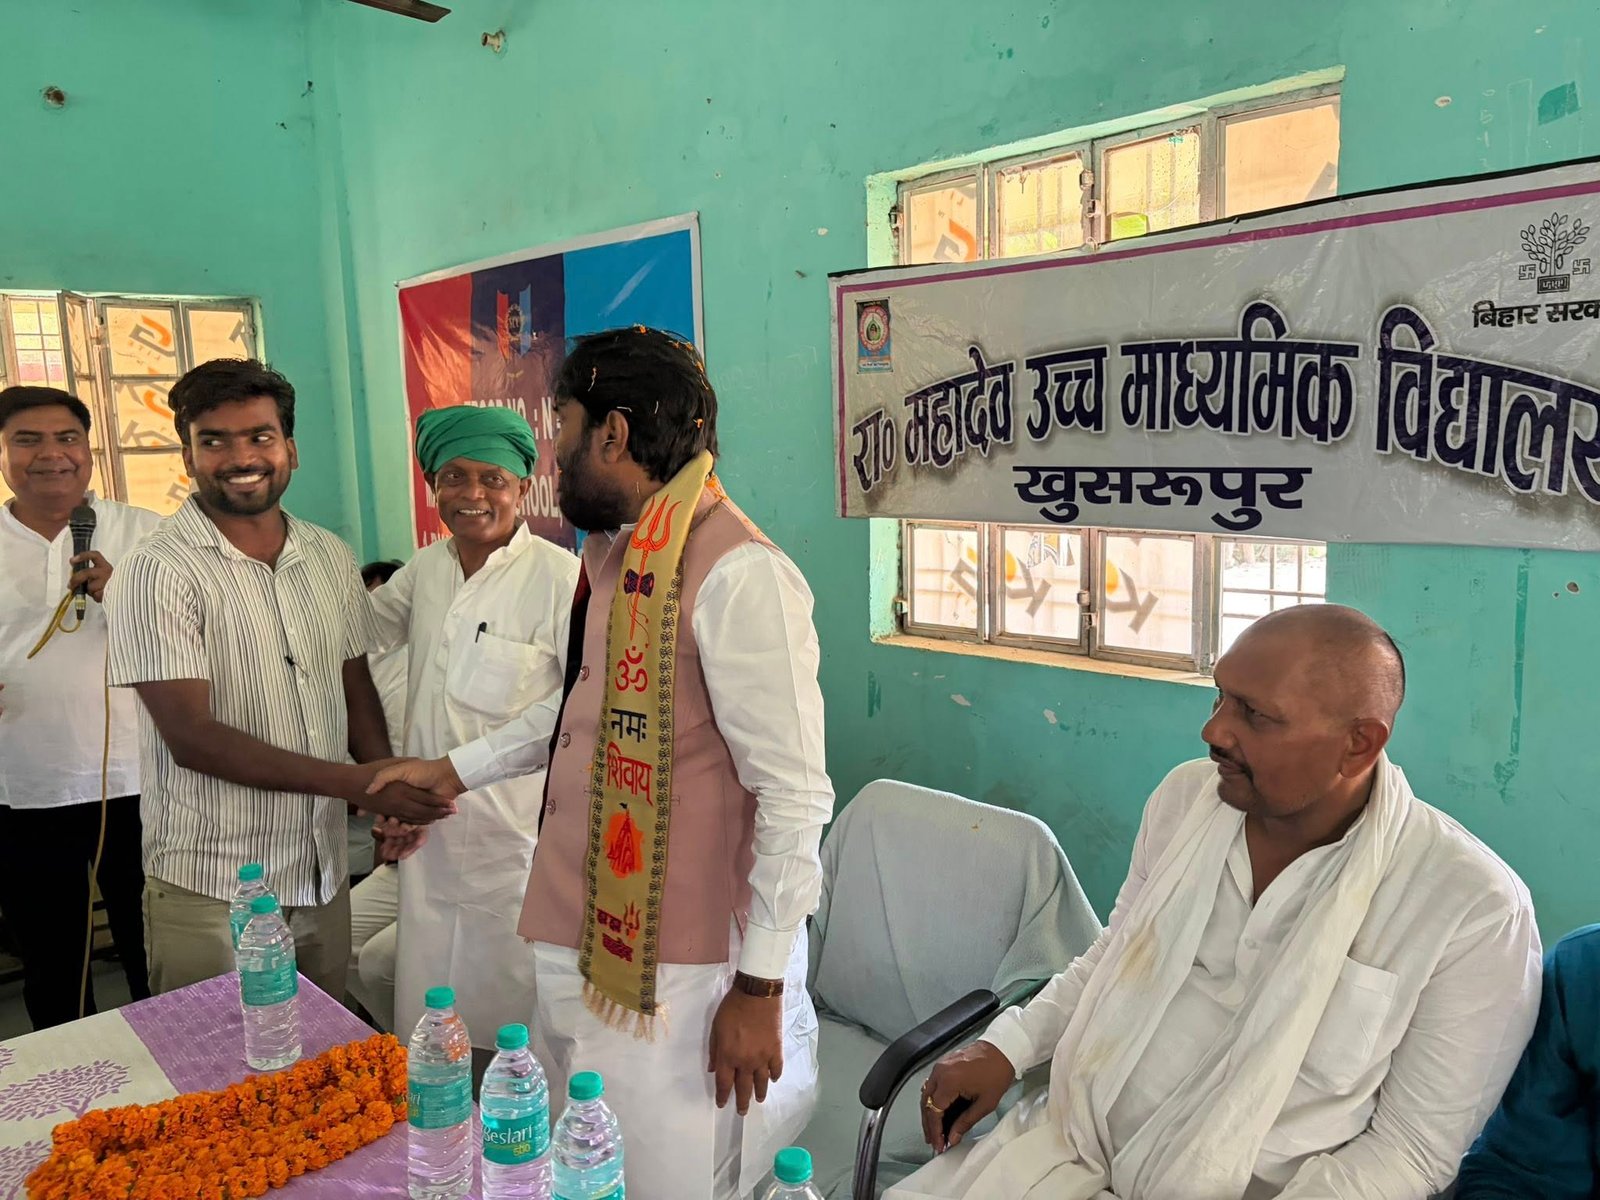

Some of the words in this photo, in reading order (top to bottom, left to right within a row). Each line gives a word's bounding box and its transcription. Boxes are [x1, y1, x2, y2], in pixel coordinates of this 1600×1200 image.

[1472, 300, 1541, 328] बिहार
[904, 345, 1015, 469] महादेव
[1025, 345, 1108, 442] उच्च
[1121, 300, 1361, 444] माध्यमिक
[1012, 466, 1312, 531] खुसरूपुर
[610, 708, 647, 743] नमः
[606, 741, 654, 806] शिवाय
